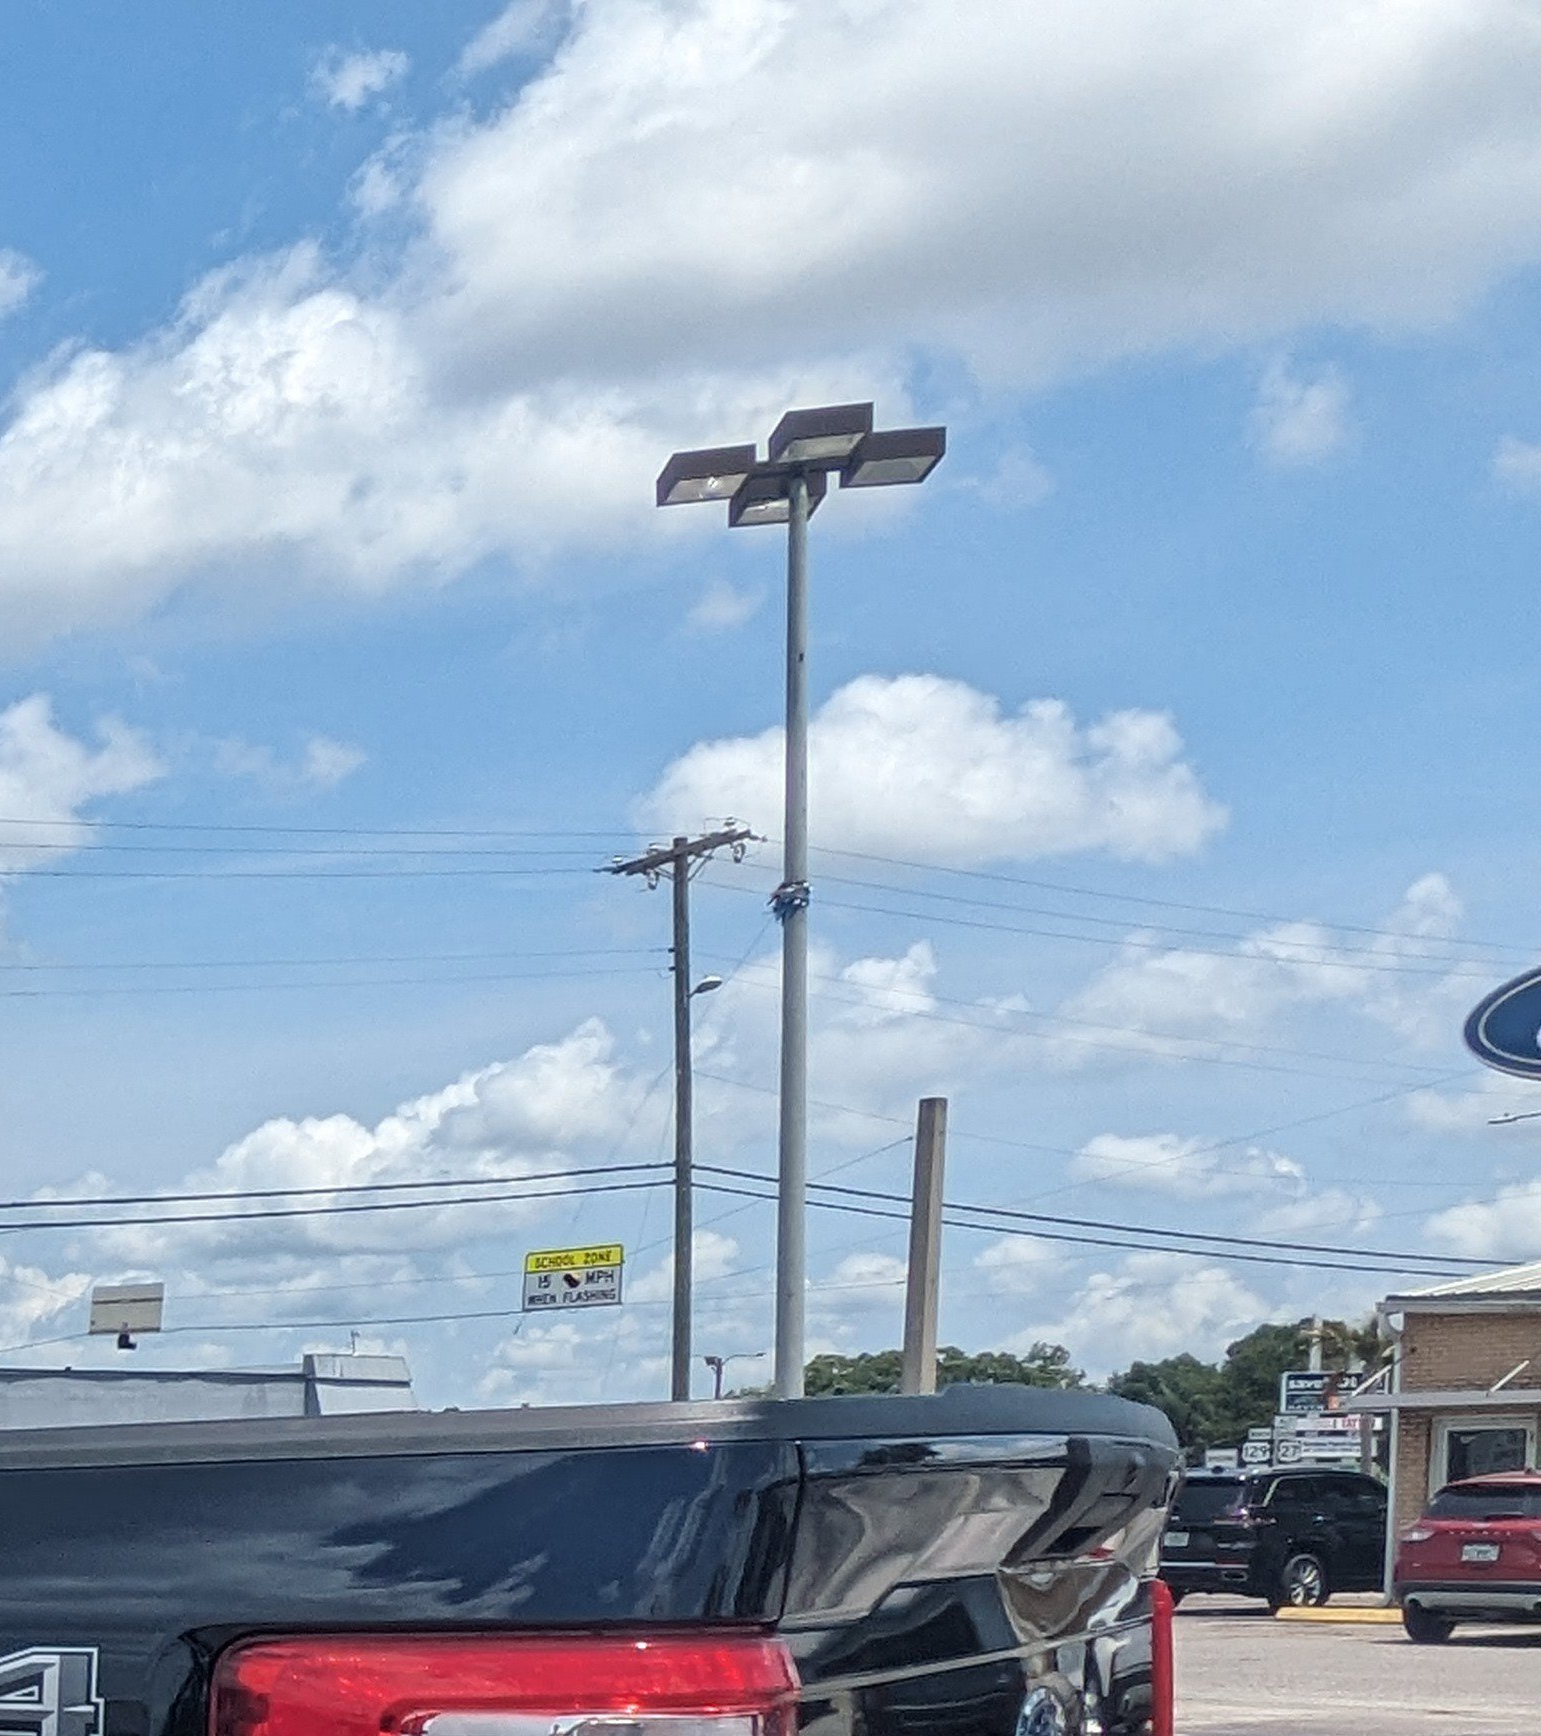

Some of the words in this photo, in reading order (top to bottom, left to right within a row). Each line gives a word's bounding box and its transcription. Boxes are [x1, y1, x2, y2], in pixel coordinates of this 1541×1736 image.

[534, 1254, 575, 1269] SCHOOL
[583, 1250, 612, 1265] ZONE
[584, 1270, 615, 1285] MPH
[527, 1293, 557, 1306] WHEN
[563, 1288, 616, 1303] FLASHING
[1244, 1444, 1268, 1458] 129
[1281, 1445, 1298, 1458] 27
